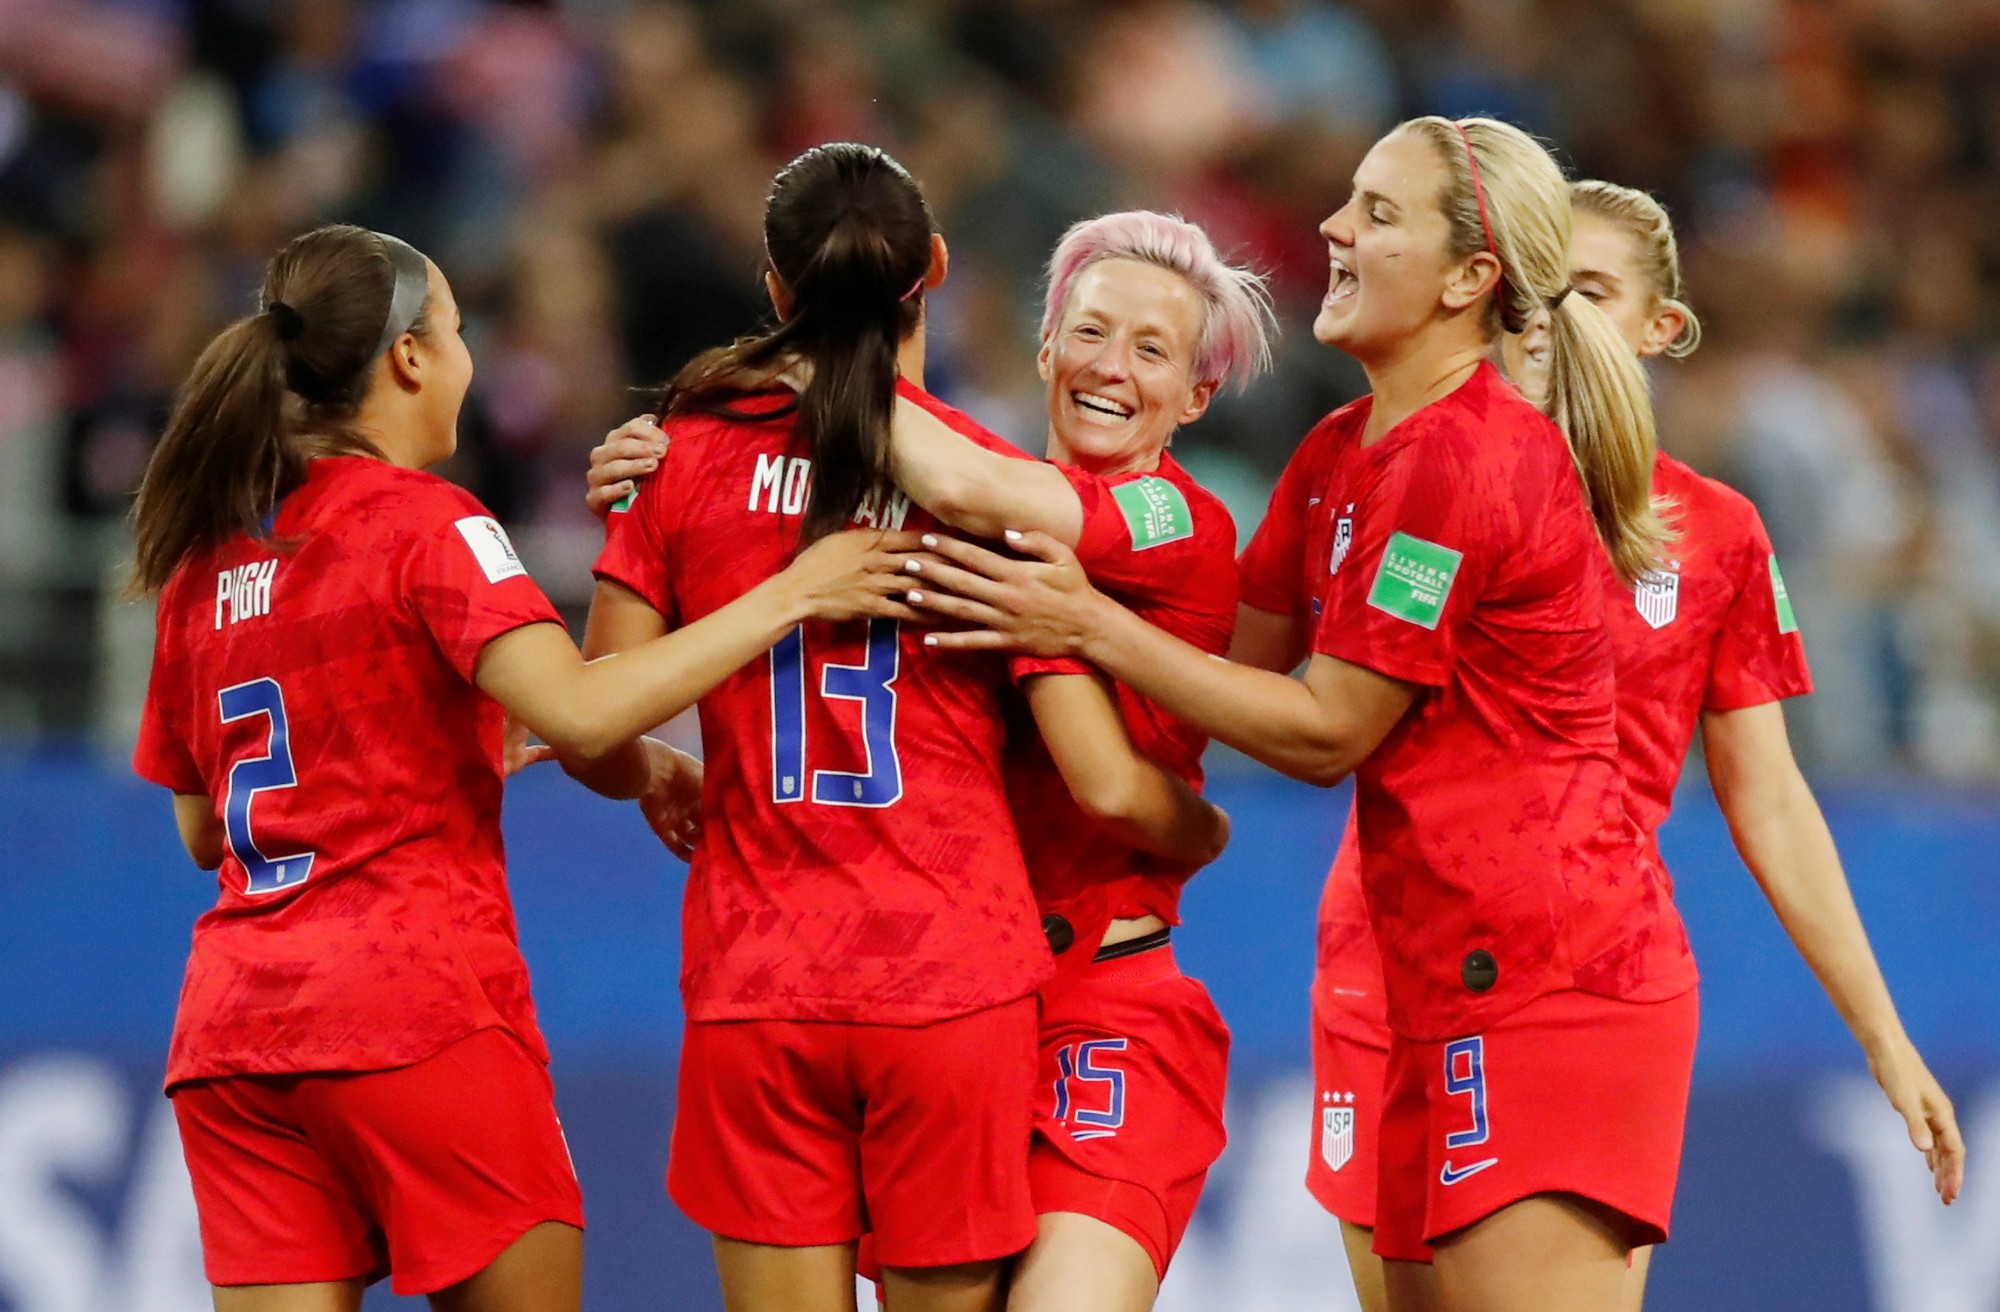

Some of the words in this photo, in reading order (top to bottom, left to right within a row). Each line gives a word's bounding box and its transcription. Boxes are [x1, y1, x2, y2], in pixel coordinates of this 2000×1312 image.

[748, 453, 912, 531] MOAN
[1143, 512, 1158, 540] FIFA
[215, 558, 278, 630] PUGH
[1387, 560, 1443, 589] FOOTBALL
[1390, 552, 1448, 581] LIVING
[1411, 588, 1439, 607] FIFA
[770, 618, 903, 808] 13
[217, 676, 316, 895] 2
[1052, 1037, 1128, 1129] 15
[1444, 1035, 1490, 1149] 9
[1325, 1112, 1351, 1135] USA
